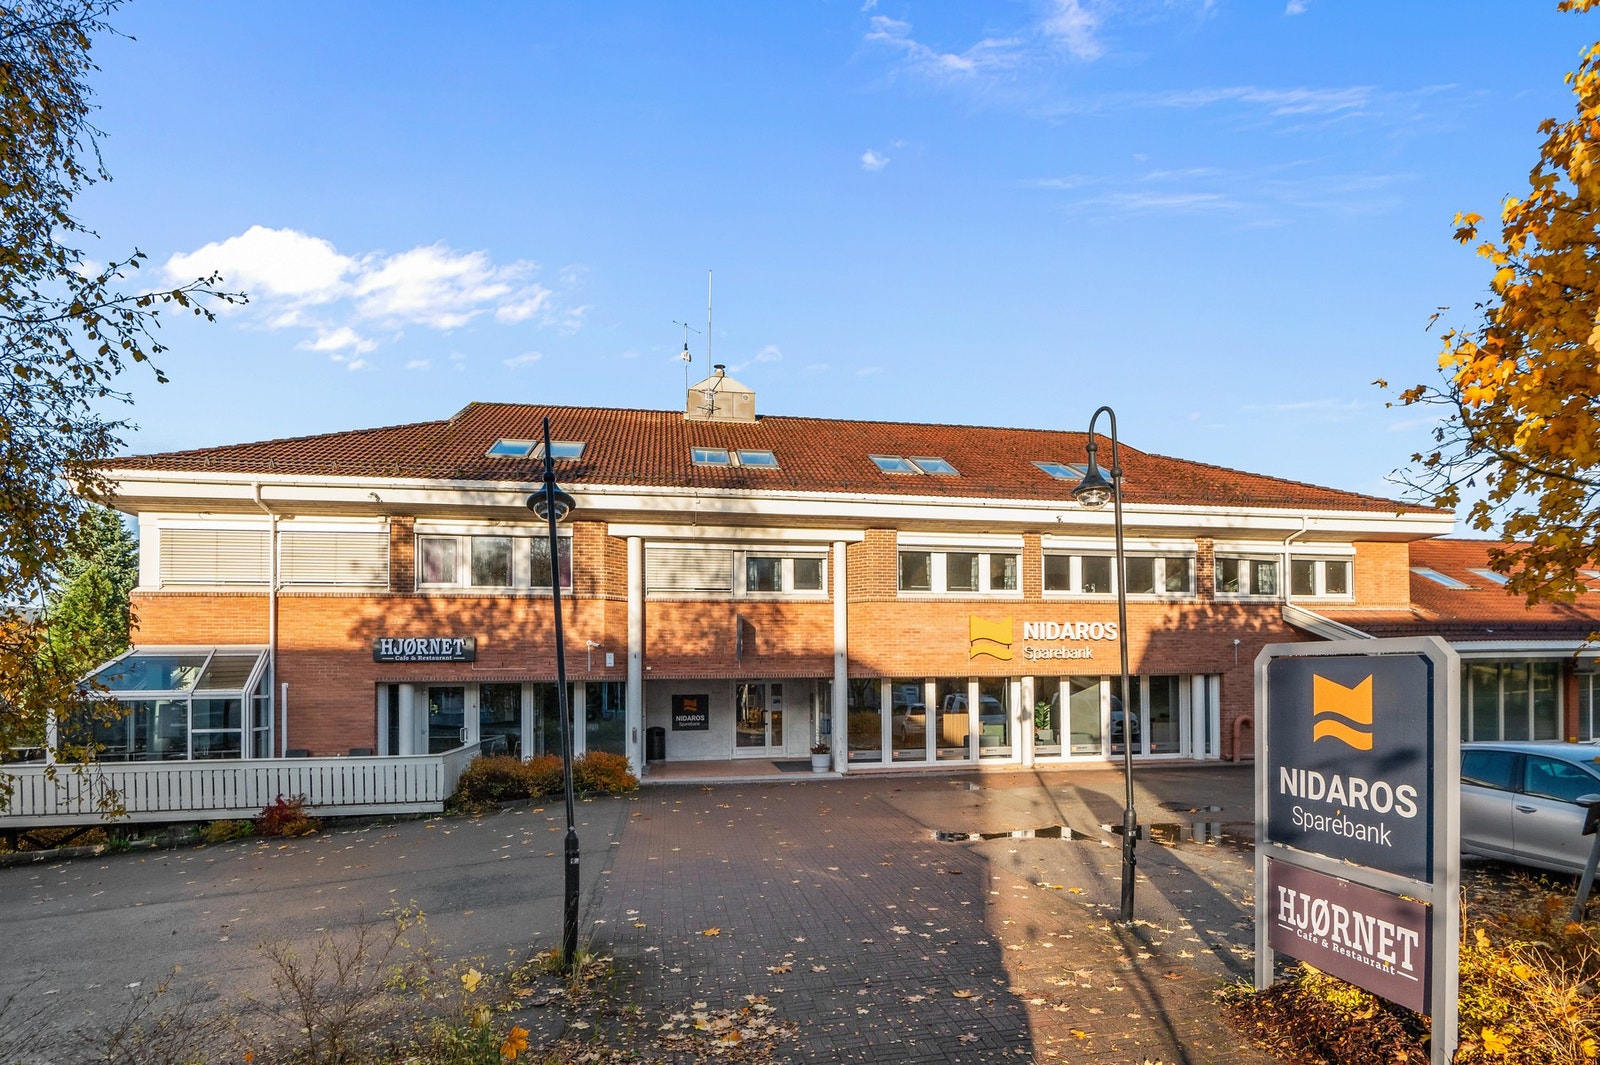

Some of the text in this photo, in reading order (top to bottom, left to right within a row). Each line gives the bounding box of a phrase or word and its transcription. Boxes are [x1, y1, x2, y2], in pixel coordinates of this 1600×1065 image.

[380, 638, 465, 655] HJØRNET
[1023, 621, 1118, 641] NIDAROS
[1024, 645, 1094, 662] Sparebank
[675, 714, 705, 722] NIDAROS
[1280, 766, 1418, 819] NIDAROS
[1292, 805, 1393, 848] Sparebank
[1278, 885, 1419, 972] HJØRNET
[1296, 928, 1396, 976] Cafe & Restaurant
